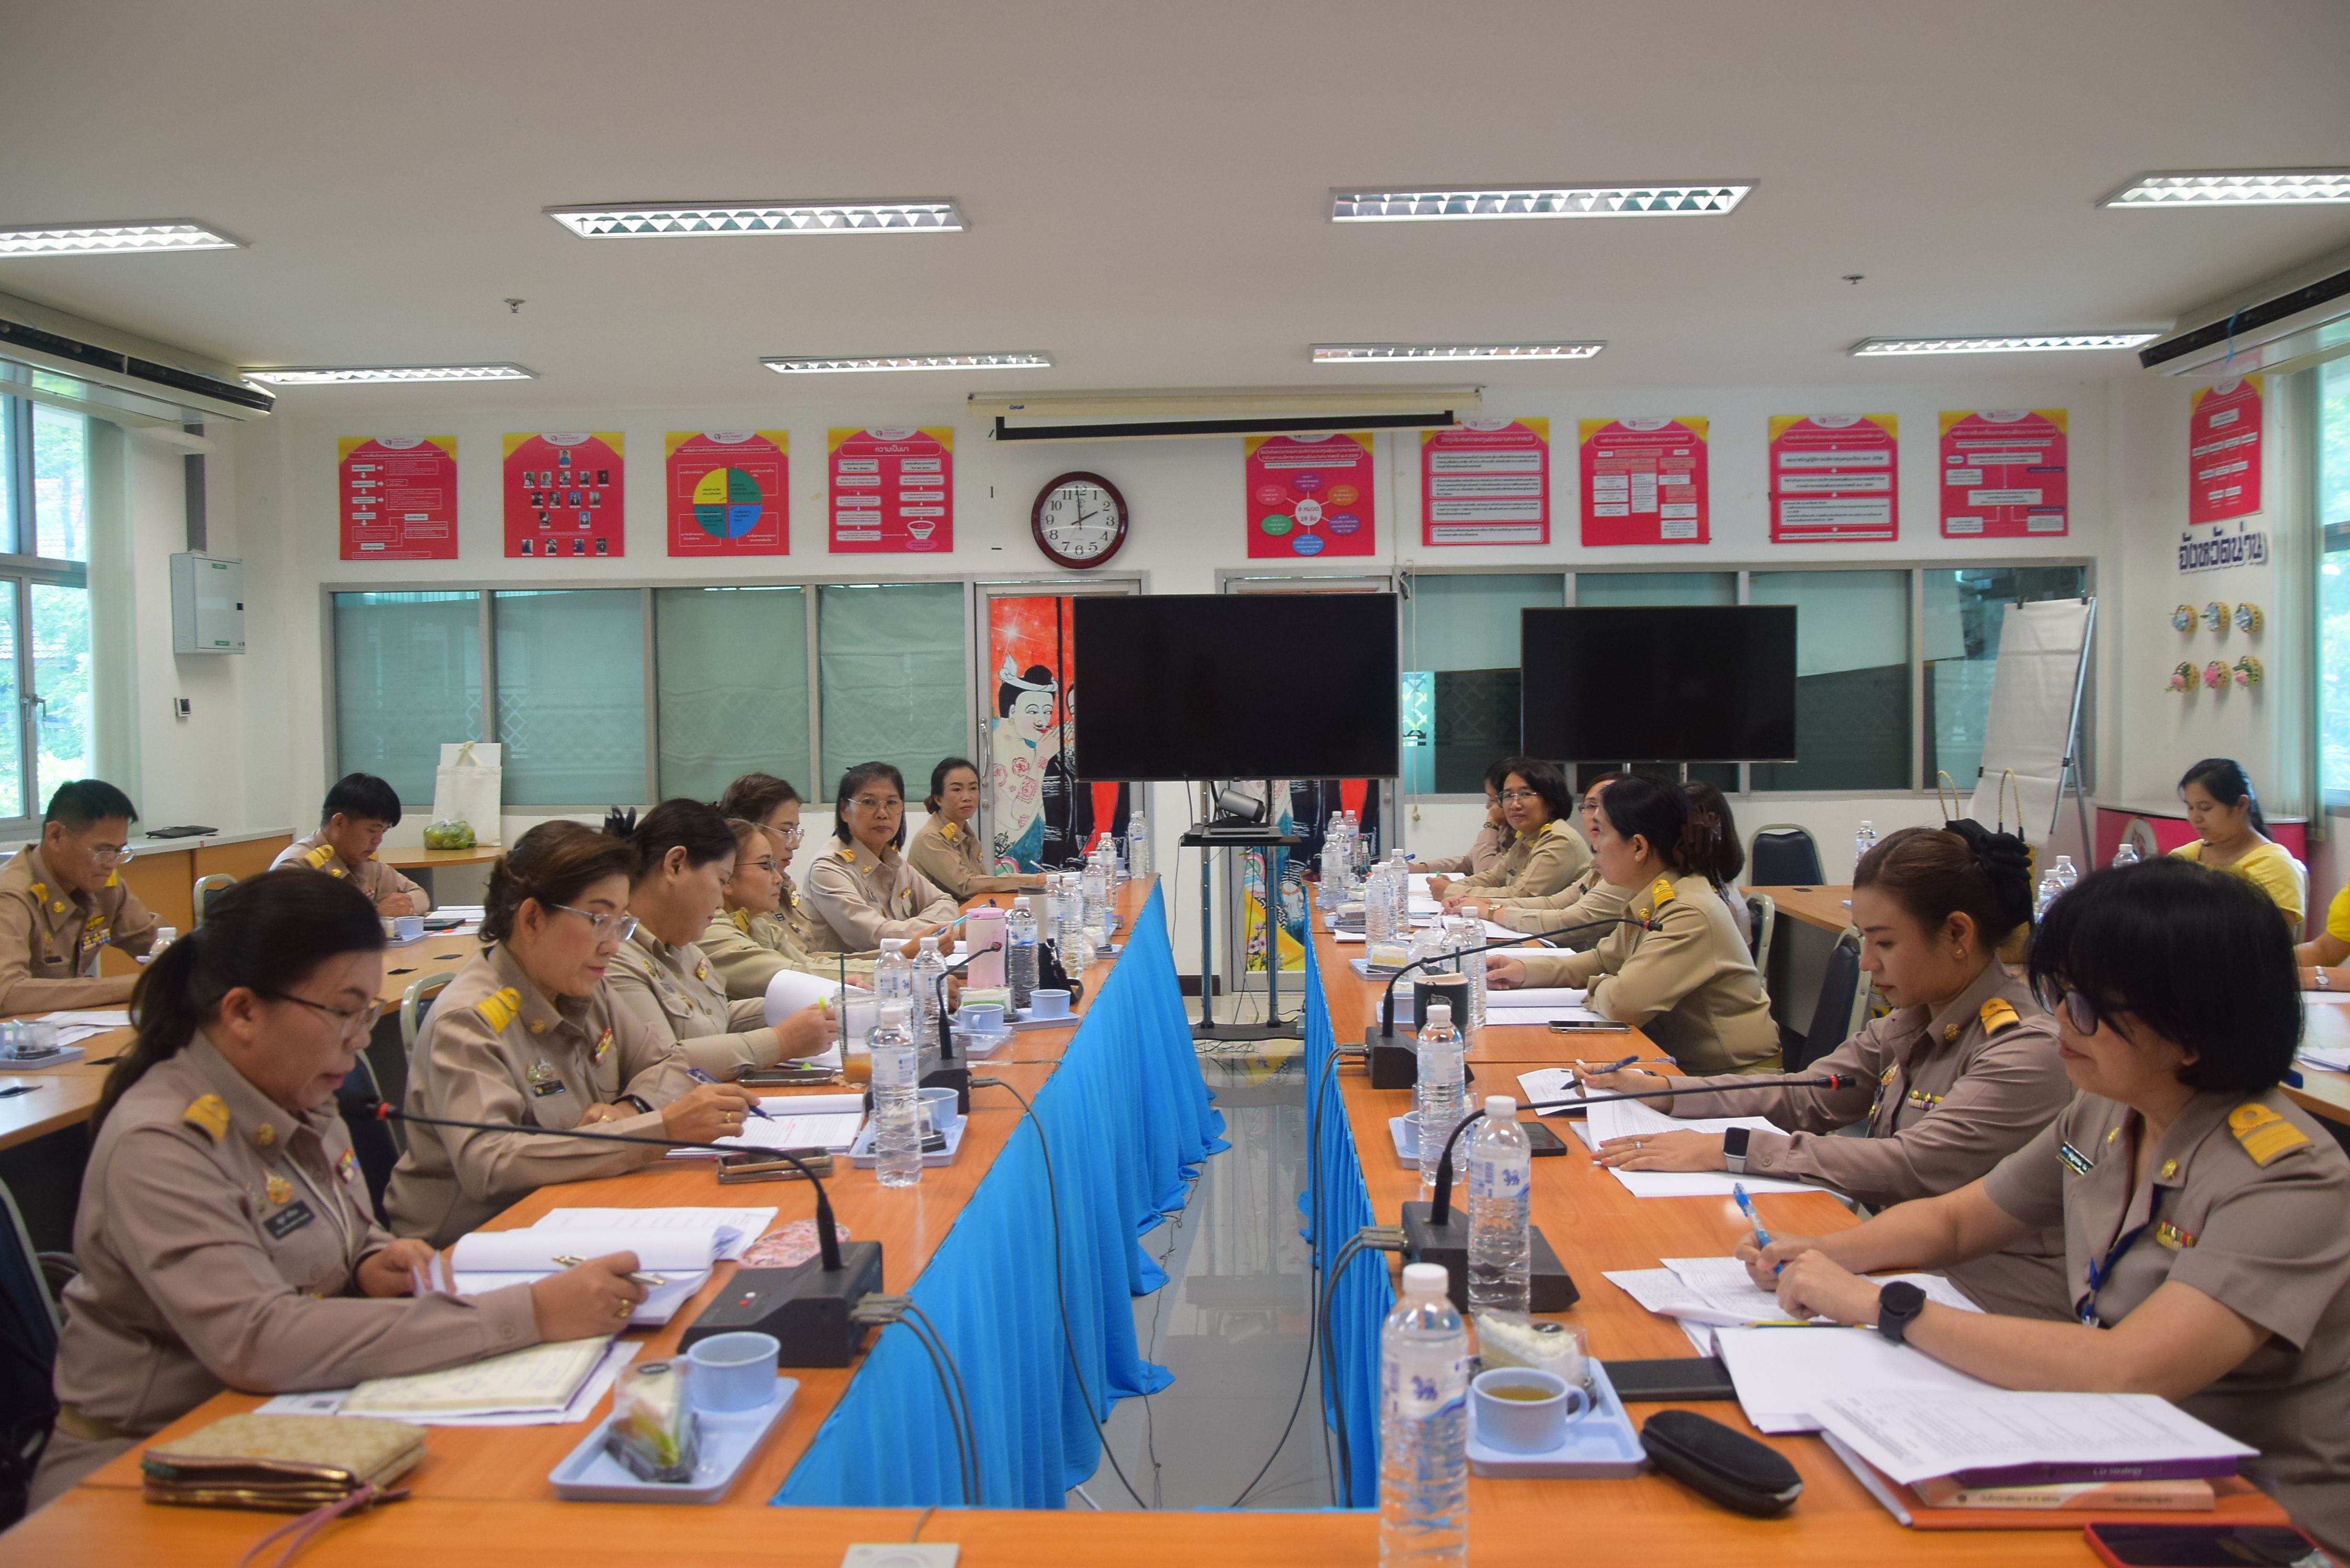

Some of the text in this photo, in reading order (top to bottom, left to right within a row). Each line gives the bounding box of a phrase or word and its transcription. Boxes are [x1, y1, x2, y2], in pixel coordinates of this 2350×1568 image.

[1063, 490, 1072, 500] 11
[1075, 486, 1087, 495] 12
[1093, 490, 1097, 500] 1
[1051, 500, 1062, 511] 10
[1103, 501, 1110, 511] 2
[1046, 515, 1054, 525] 9
[1106, 516, 1114, 526] 3
[1050, 529, 1058, 539] 8
[1100, 531, 1108, 541] 4
[1062, 542, 1070, 551] 7
[1075, 545, 1084, 555] 6
[1089, 542, 1098, 552] 5
[2179, 521, 2262, 570] จังหวัดน่าน
